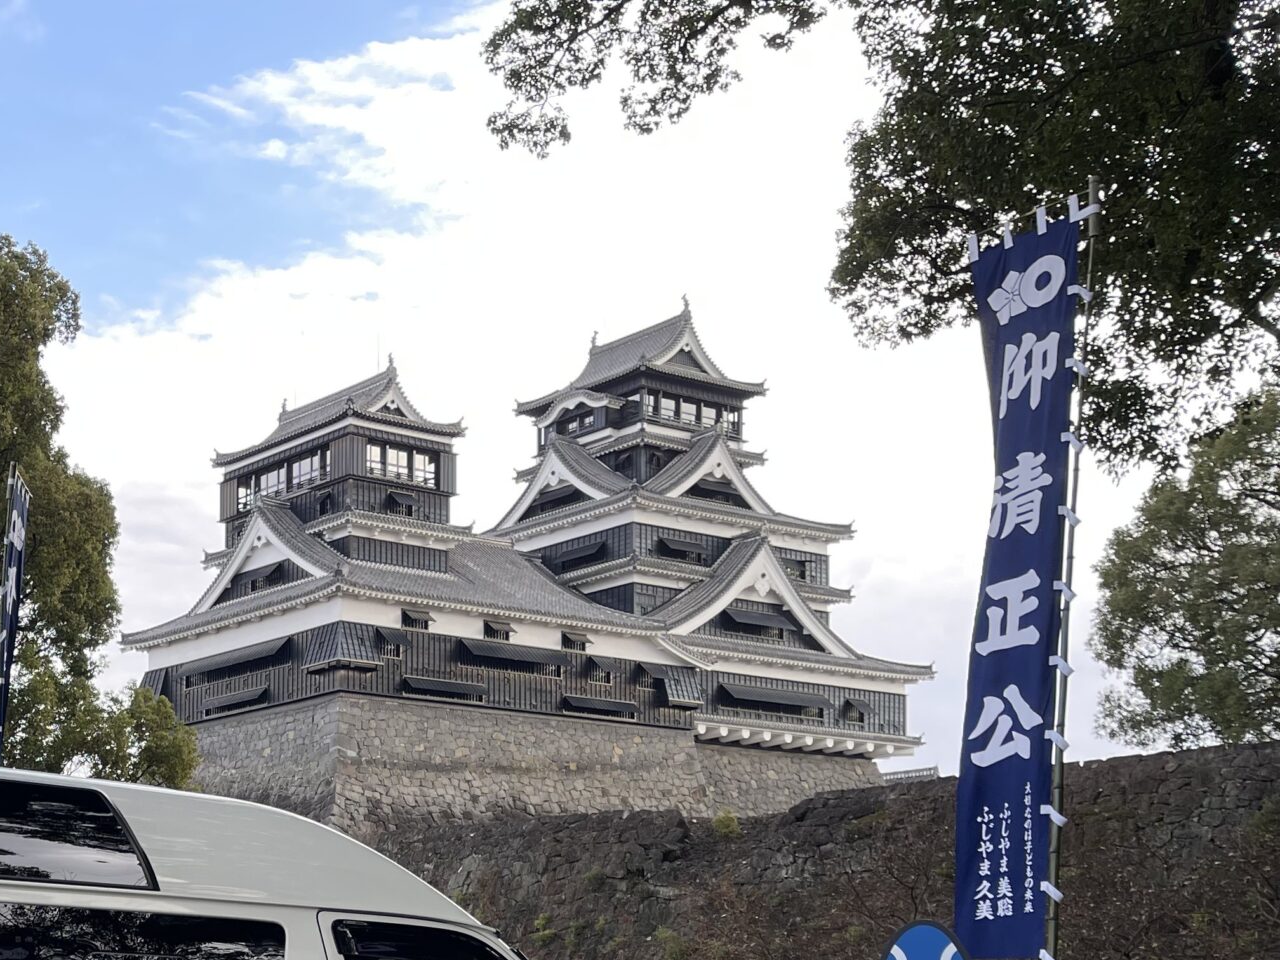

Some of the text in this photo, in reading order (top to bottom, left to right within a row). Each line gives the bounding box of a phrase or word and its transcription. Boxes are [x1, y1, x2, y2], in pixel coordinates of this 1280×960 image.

[973, 806, 995, 921] ふじやま 久美
[998, 802, 1011, 873] ふじやま
